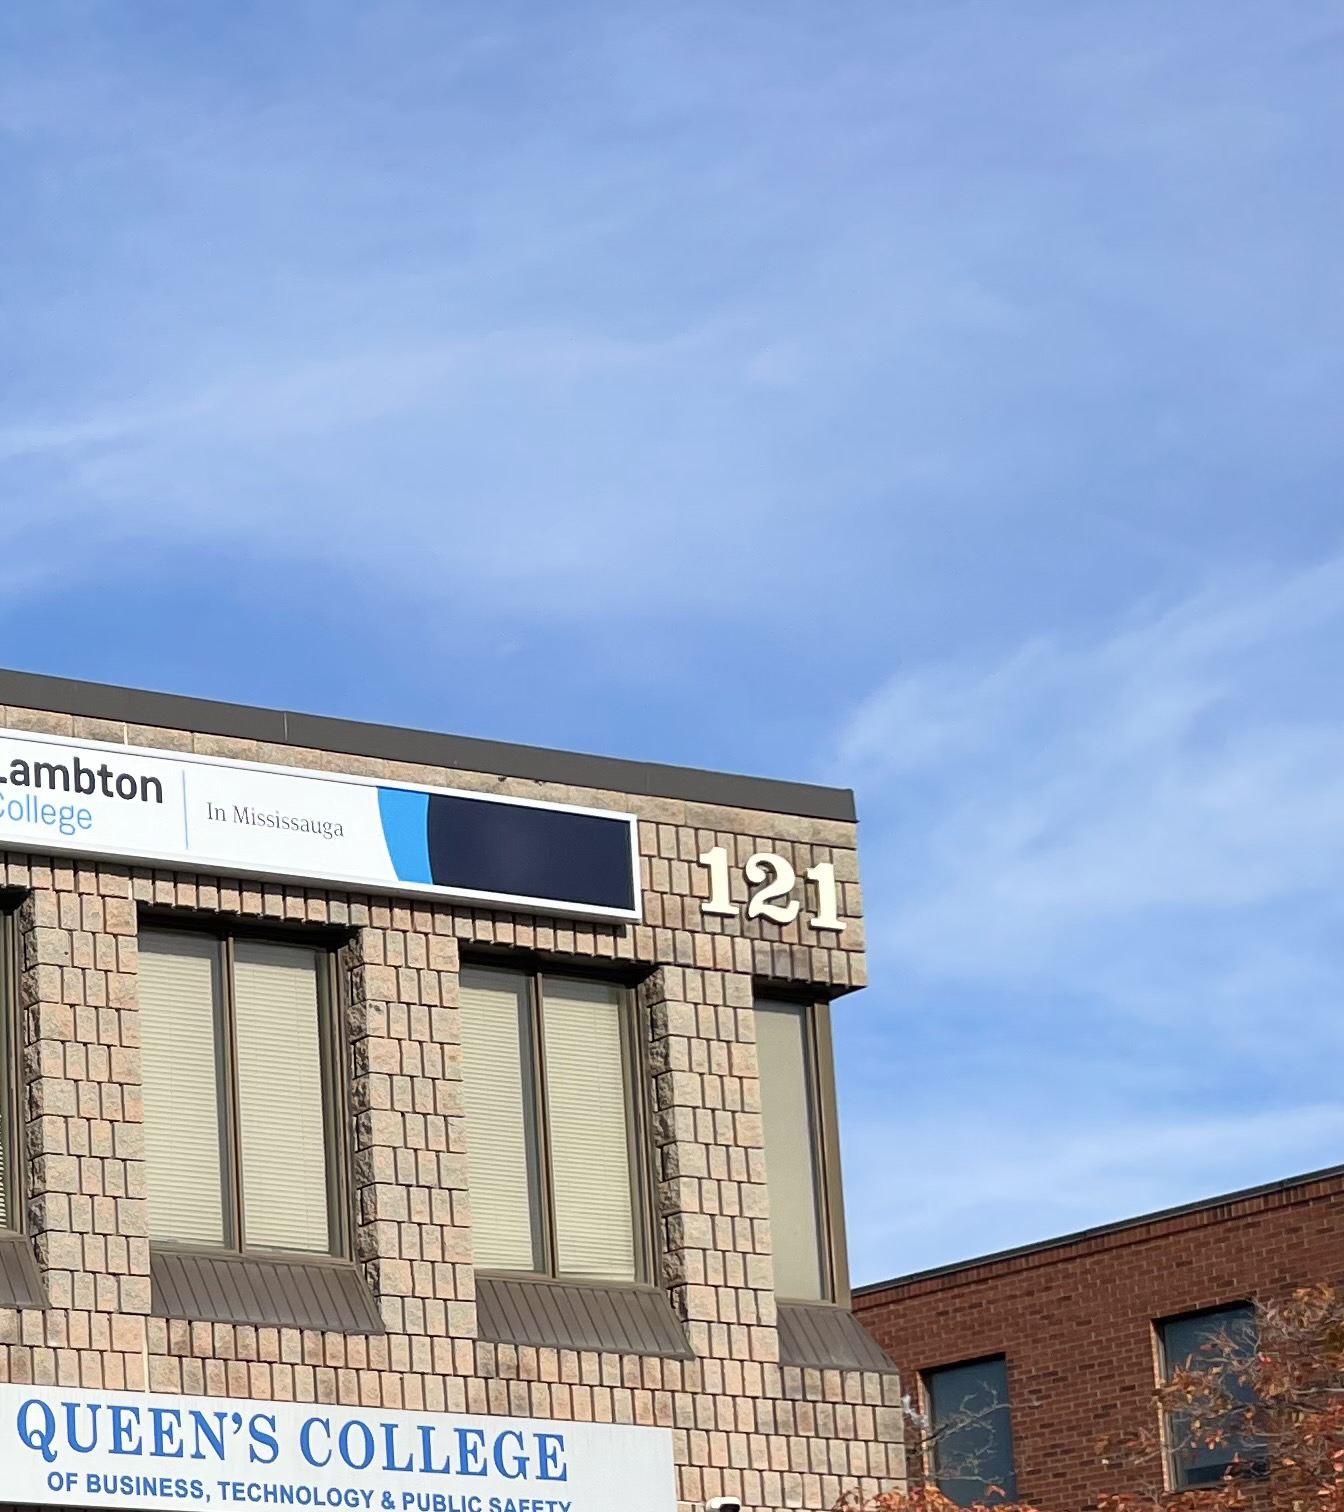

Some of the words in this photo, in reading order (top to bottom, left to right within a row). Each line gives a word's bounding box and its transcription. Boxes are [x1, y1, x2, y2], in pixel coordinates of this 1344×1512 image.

[206, 801, 227, 822] In
[232, 804, 344, 840] Mississauga
[699, 846, 847, 931] 121
[16, 1398, 280, 1464] QUEEN'S
[299, 1416, 568, 1482] COLLEGE
[46, 1471, 79, 1493] OF
[86, 1473, 211, 1503] BUSINESS,
[217, 1481, 374, 1509] TECHNOLOGY
[380, 1490, 396, 1510] &
